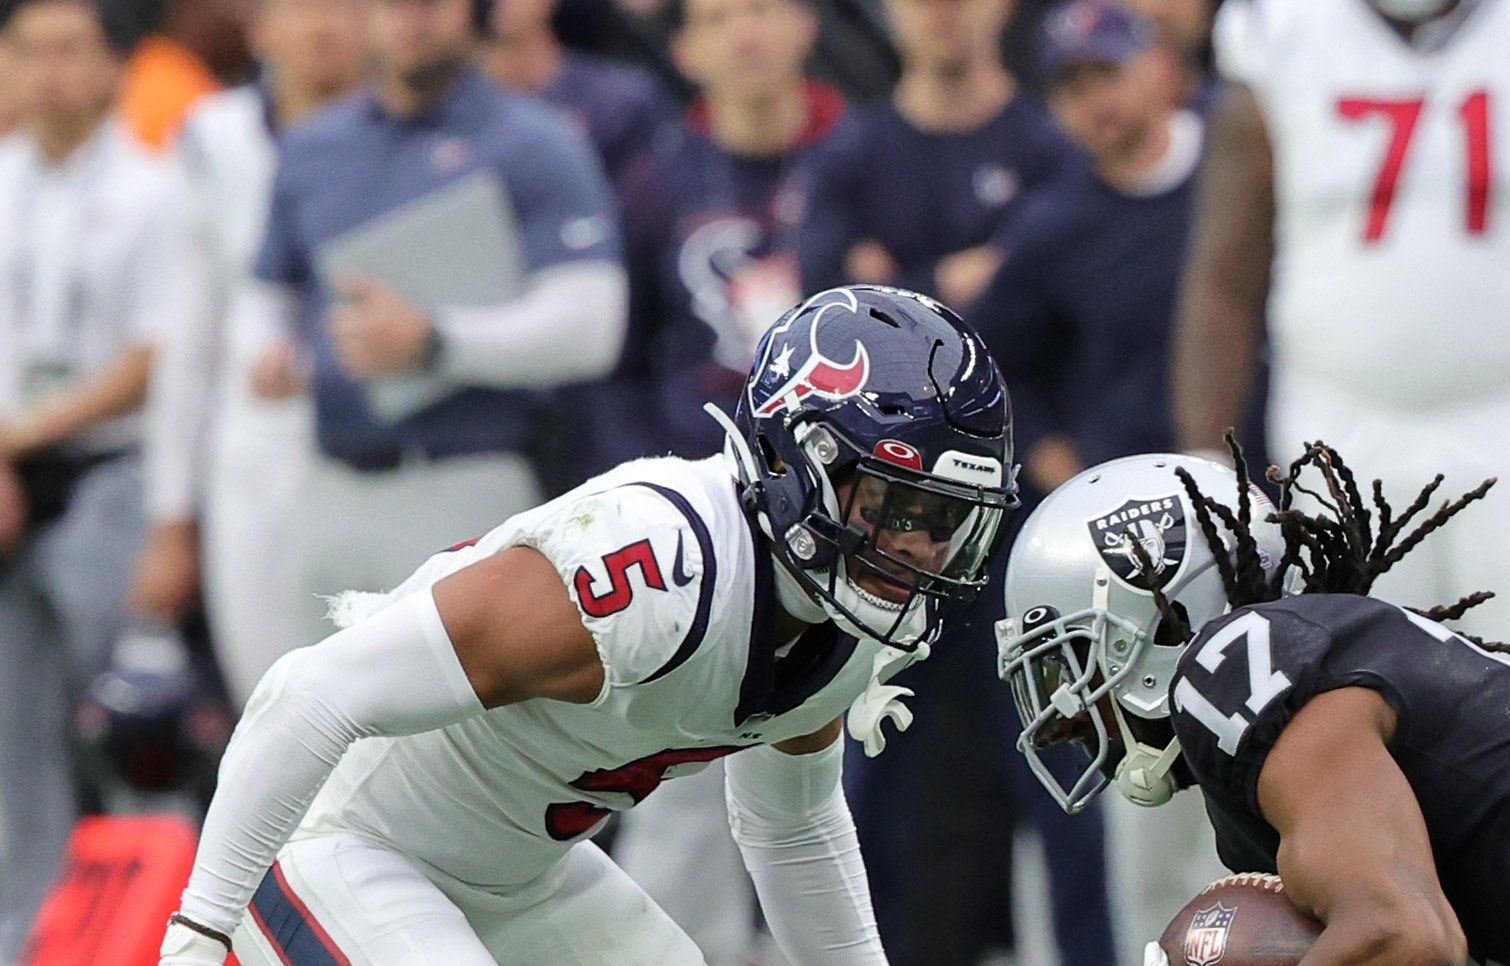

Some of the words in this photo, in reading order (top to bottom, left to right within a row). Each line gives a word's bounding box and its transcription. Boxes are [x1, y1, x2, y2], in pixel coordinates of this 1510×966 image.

[1336, 88, 1490, 243] 71
[953, 459, 997, 474] TEXANS
[1095, 498, 1175, 530] RAIDERS
[573, 537, 669, 618] 5
[1174, 610, 1293, 756] 17
[1188, 929, 1220, 961] NFL
